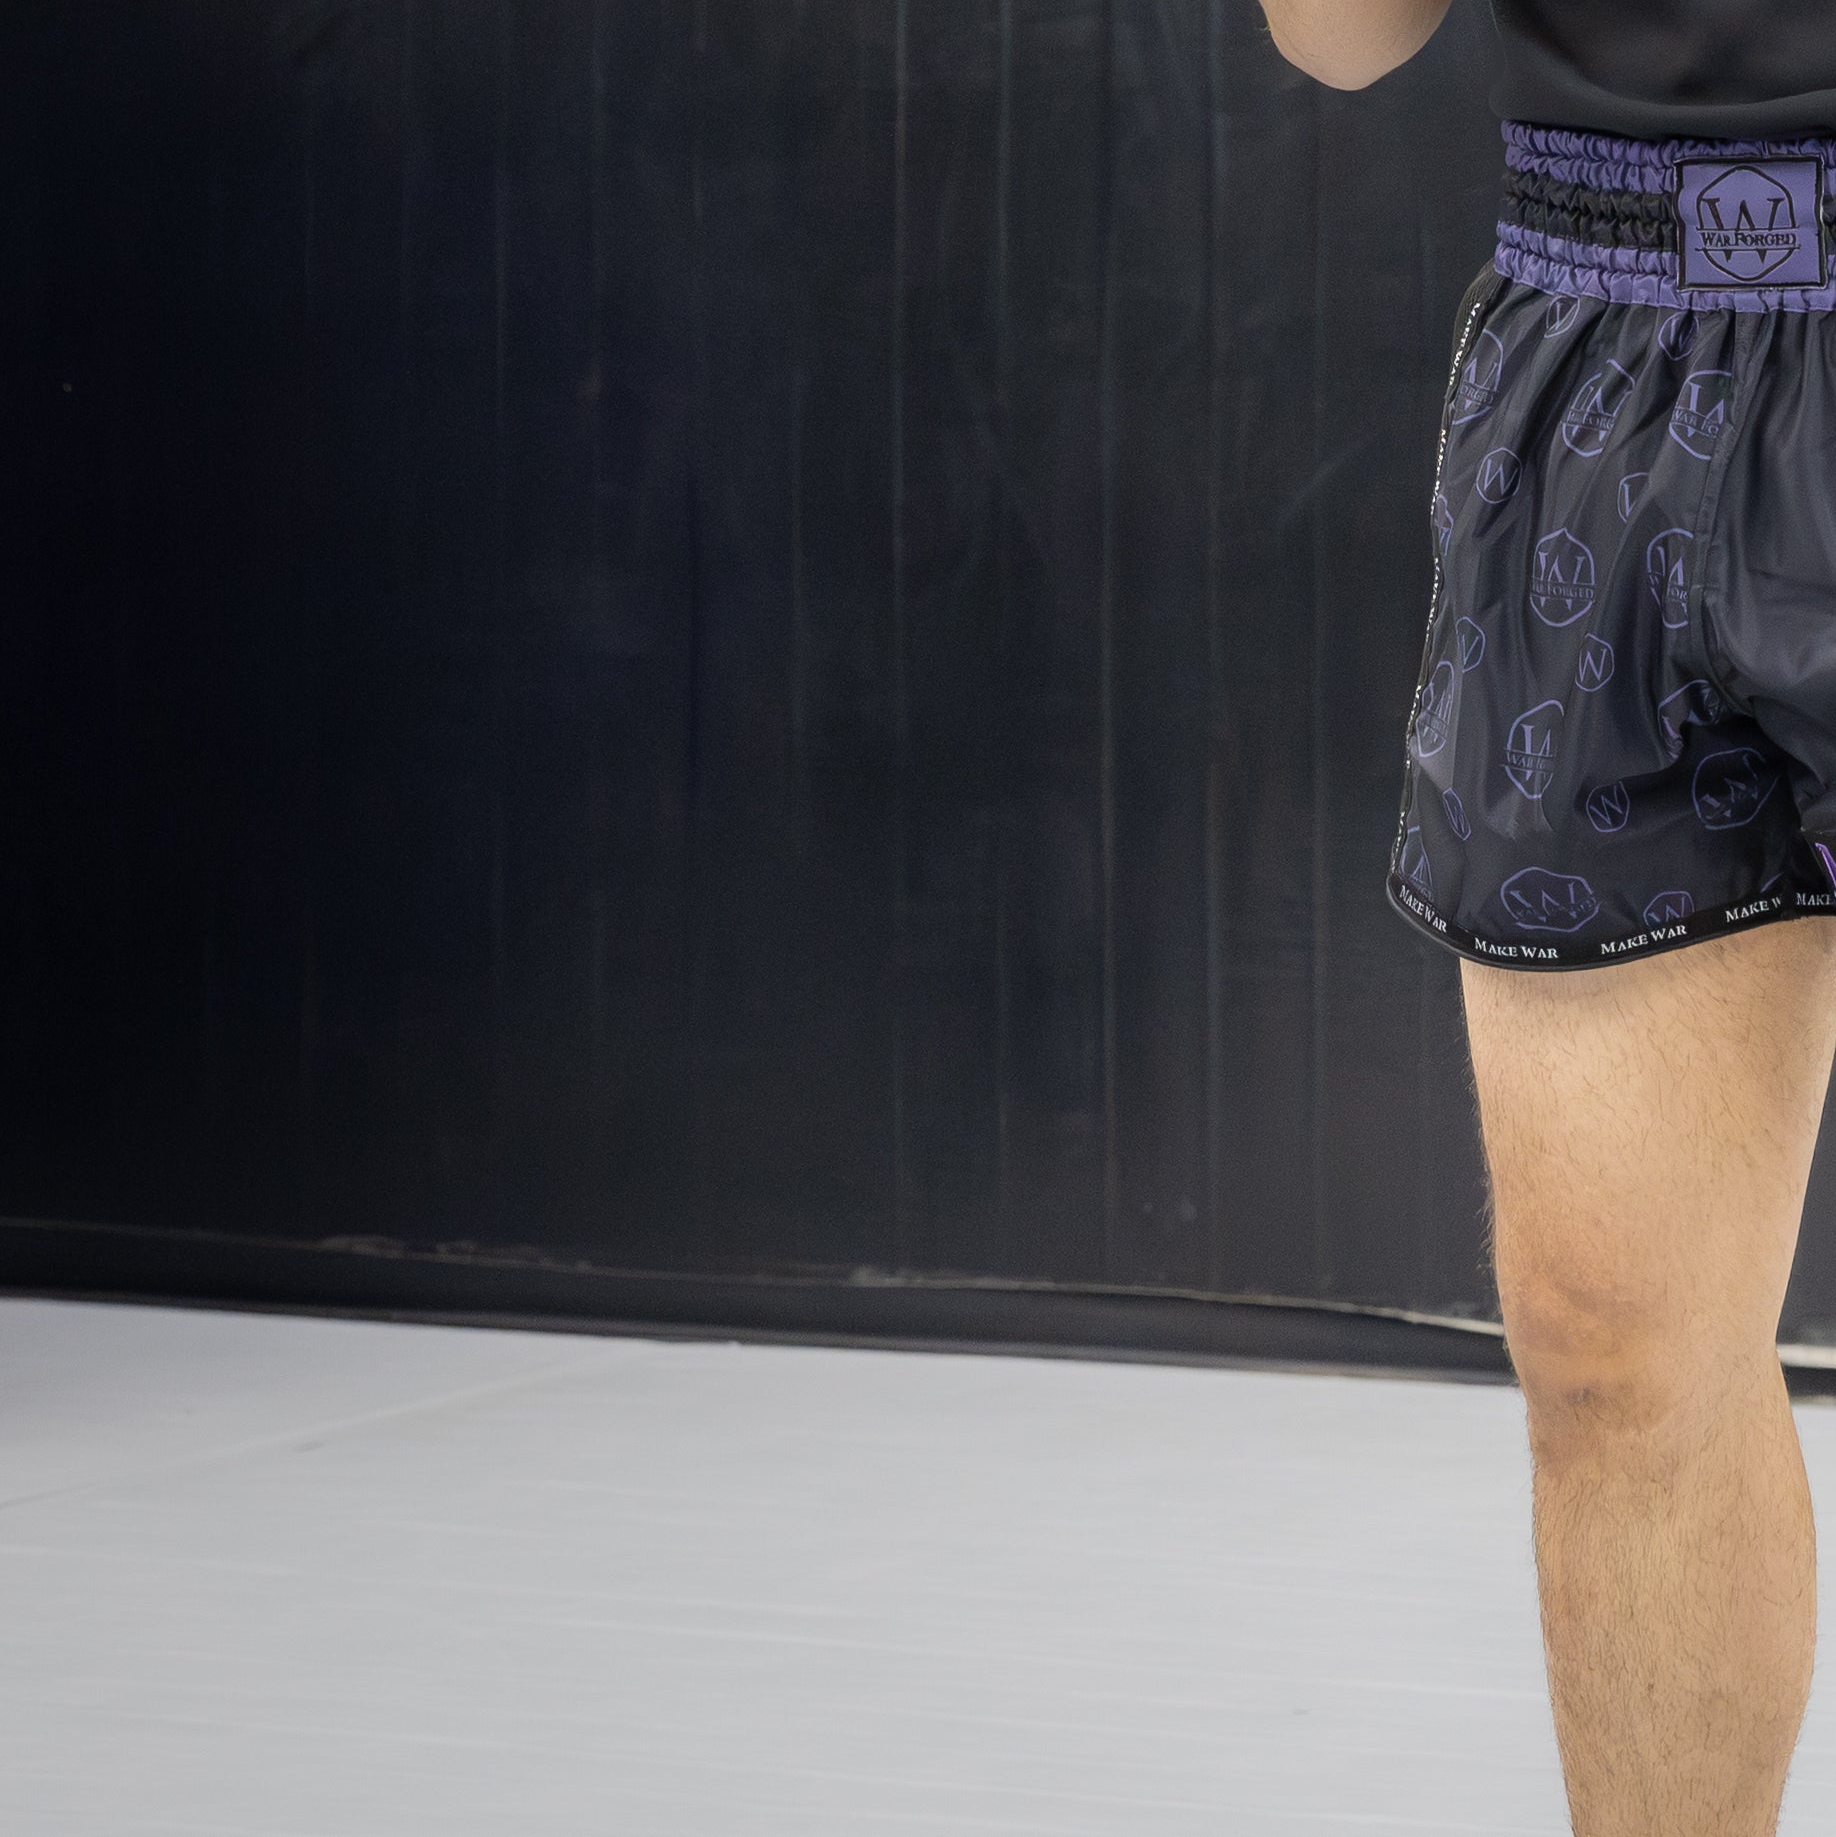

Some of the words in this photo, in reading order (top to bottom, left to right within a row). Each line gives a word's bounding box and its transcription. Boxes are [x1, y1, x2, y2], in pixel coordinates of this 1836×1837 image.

[1701, 232, 1732, 247] WAR
[1734, 231, 1797, 247] FORGED
[1400, 884, 1425, 916] MAKE
[1424, 902, 1448, 933] WAR
[1725, 900, 1770, 923] MAKE
[1474, 937, 1518, 957] MAKE
[1520, 945, 1559, 959] WAR
[1600, 933, 1648, 956] MAKE
[1650, 924, 1688, 943] WAR
